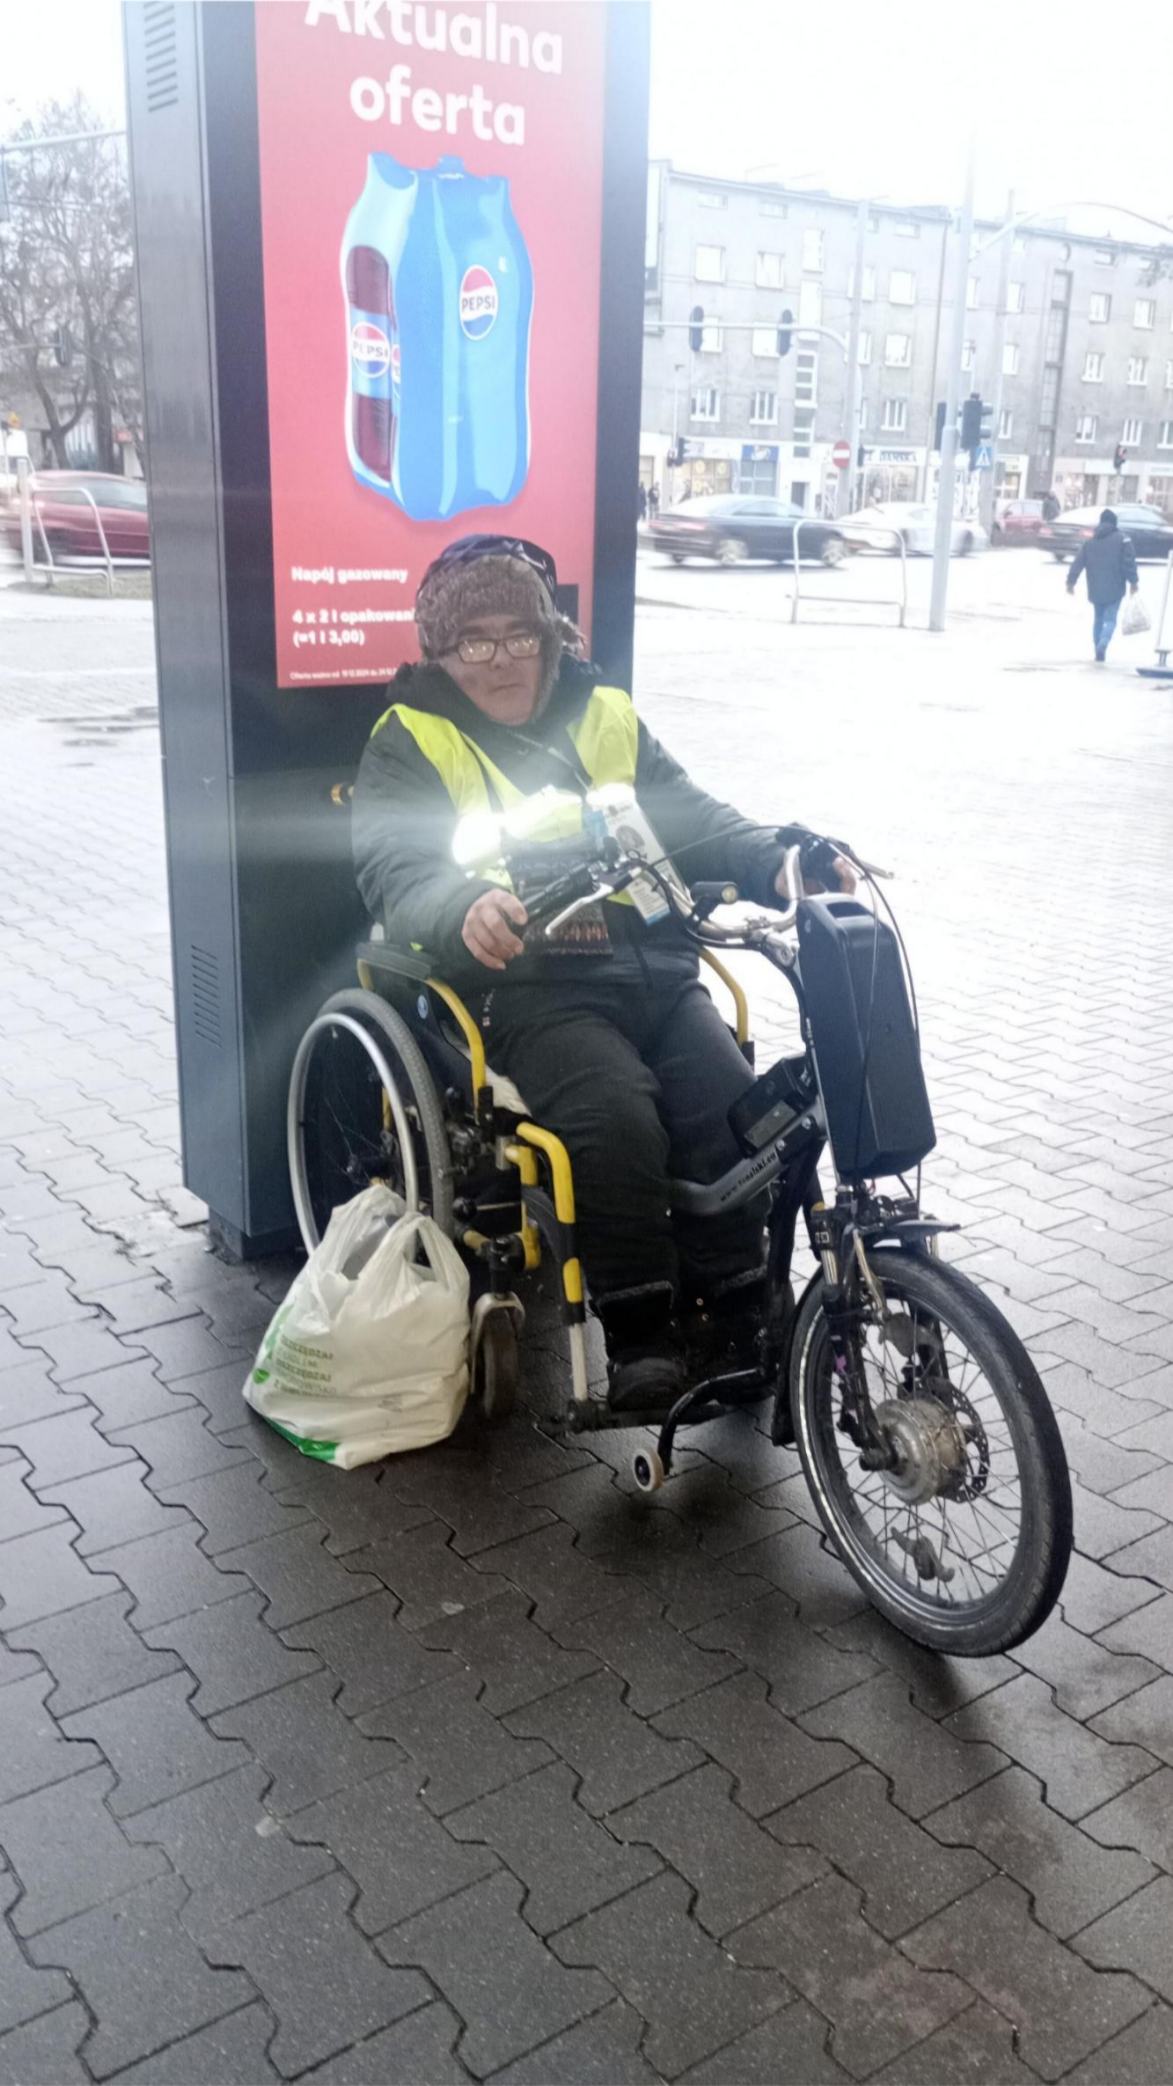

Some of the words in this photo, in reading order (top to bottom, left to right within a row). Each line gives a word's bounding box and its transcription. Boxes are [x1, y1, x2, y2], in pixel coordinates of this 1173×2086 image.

[304, 0, 562, 75] Aktualna
[350, 64, 526, 146] oferta
[461, 295, 496, 313] PEPSI
[352, 340, 389, 358] PEPSI
[292, 566, 335, 584] Napój
[337, 568, 408, 584] gazowany
[292, 608, 303, 624] 4
[306, 611, 316, 624] x
[319, 608, 329, 624] 2
[340, 607, 415, 625] opakowani
[328, 629, 365, 647] 3,00)
